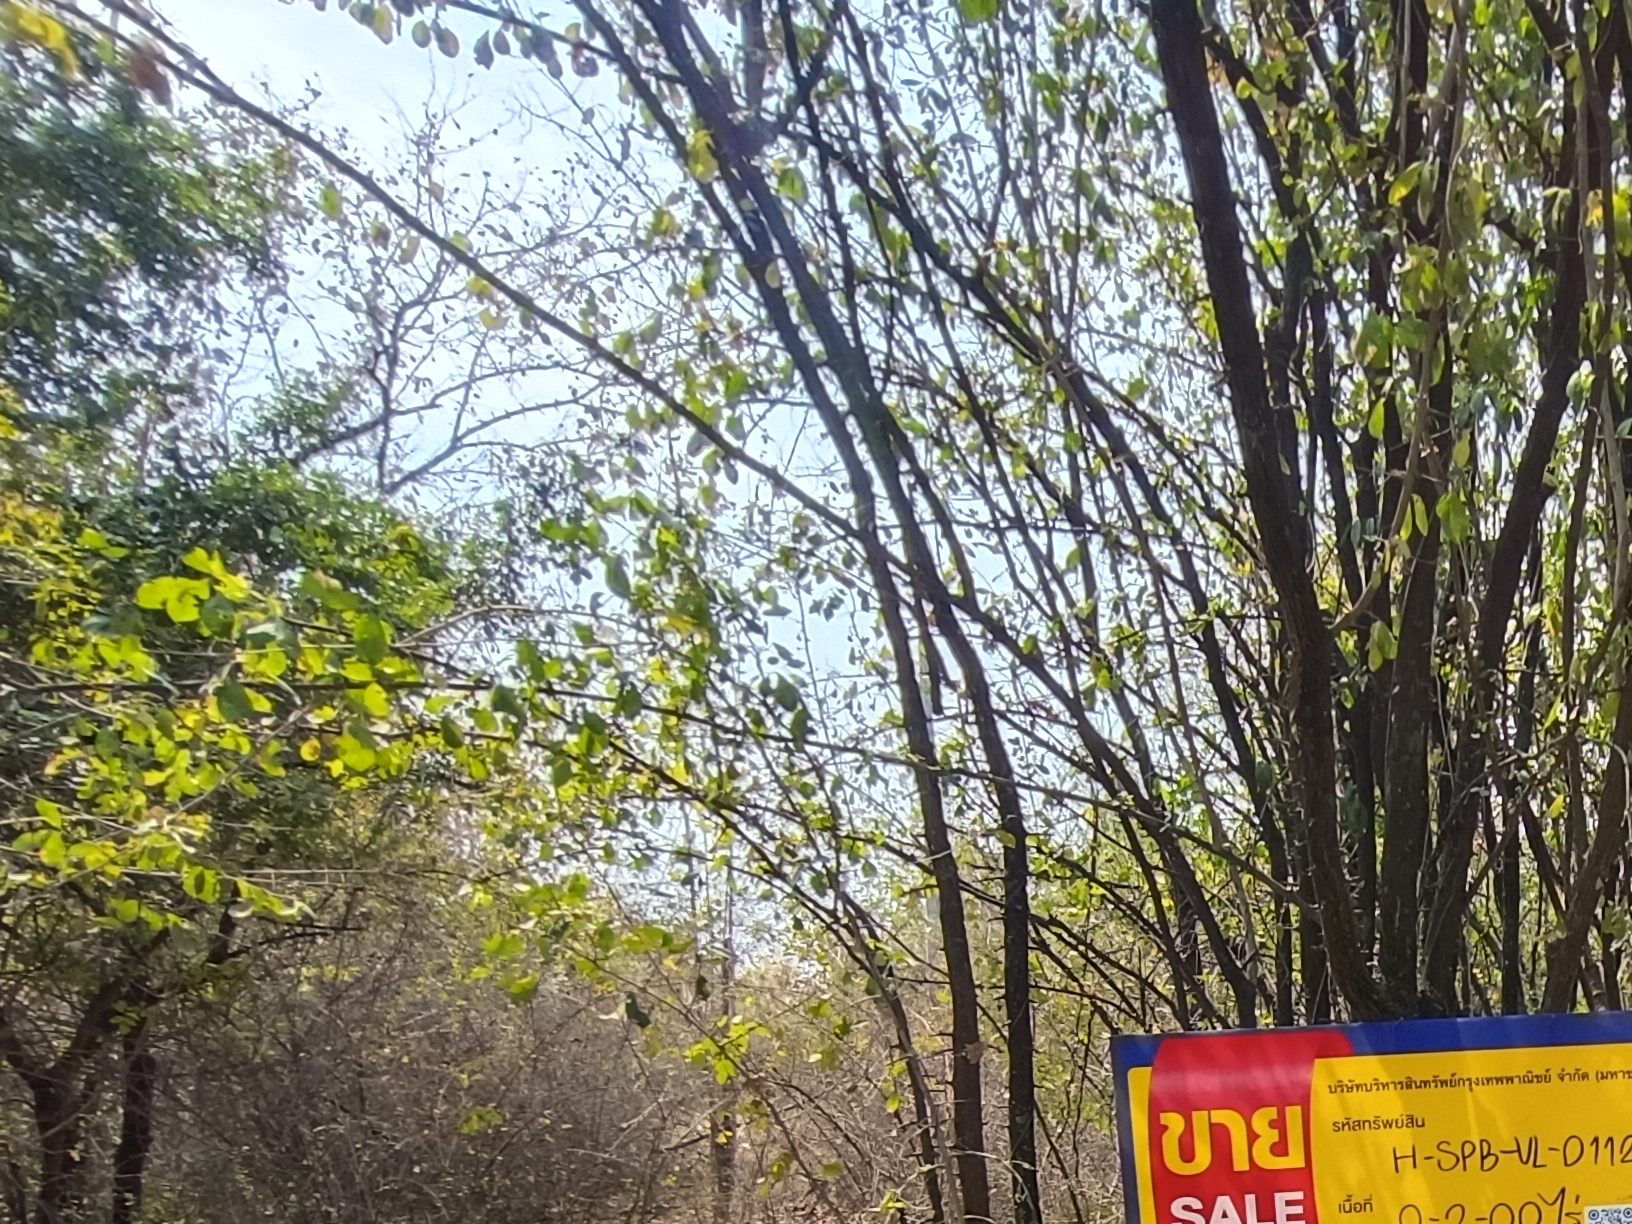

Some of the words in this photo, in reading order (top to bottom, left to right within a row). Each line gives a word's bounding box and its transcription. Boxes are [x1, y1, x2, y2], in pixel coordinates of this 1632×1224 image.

[1557, 1068, 1590, 1082] จำกัด
[1332, 1114, 1426, 1132] รหัสทรัพย์สิน
[1159, 1105, 1306, 1176] ขาย
[1338, 1193, 1373, 1213] เนื้อที่
